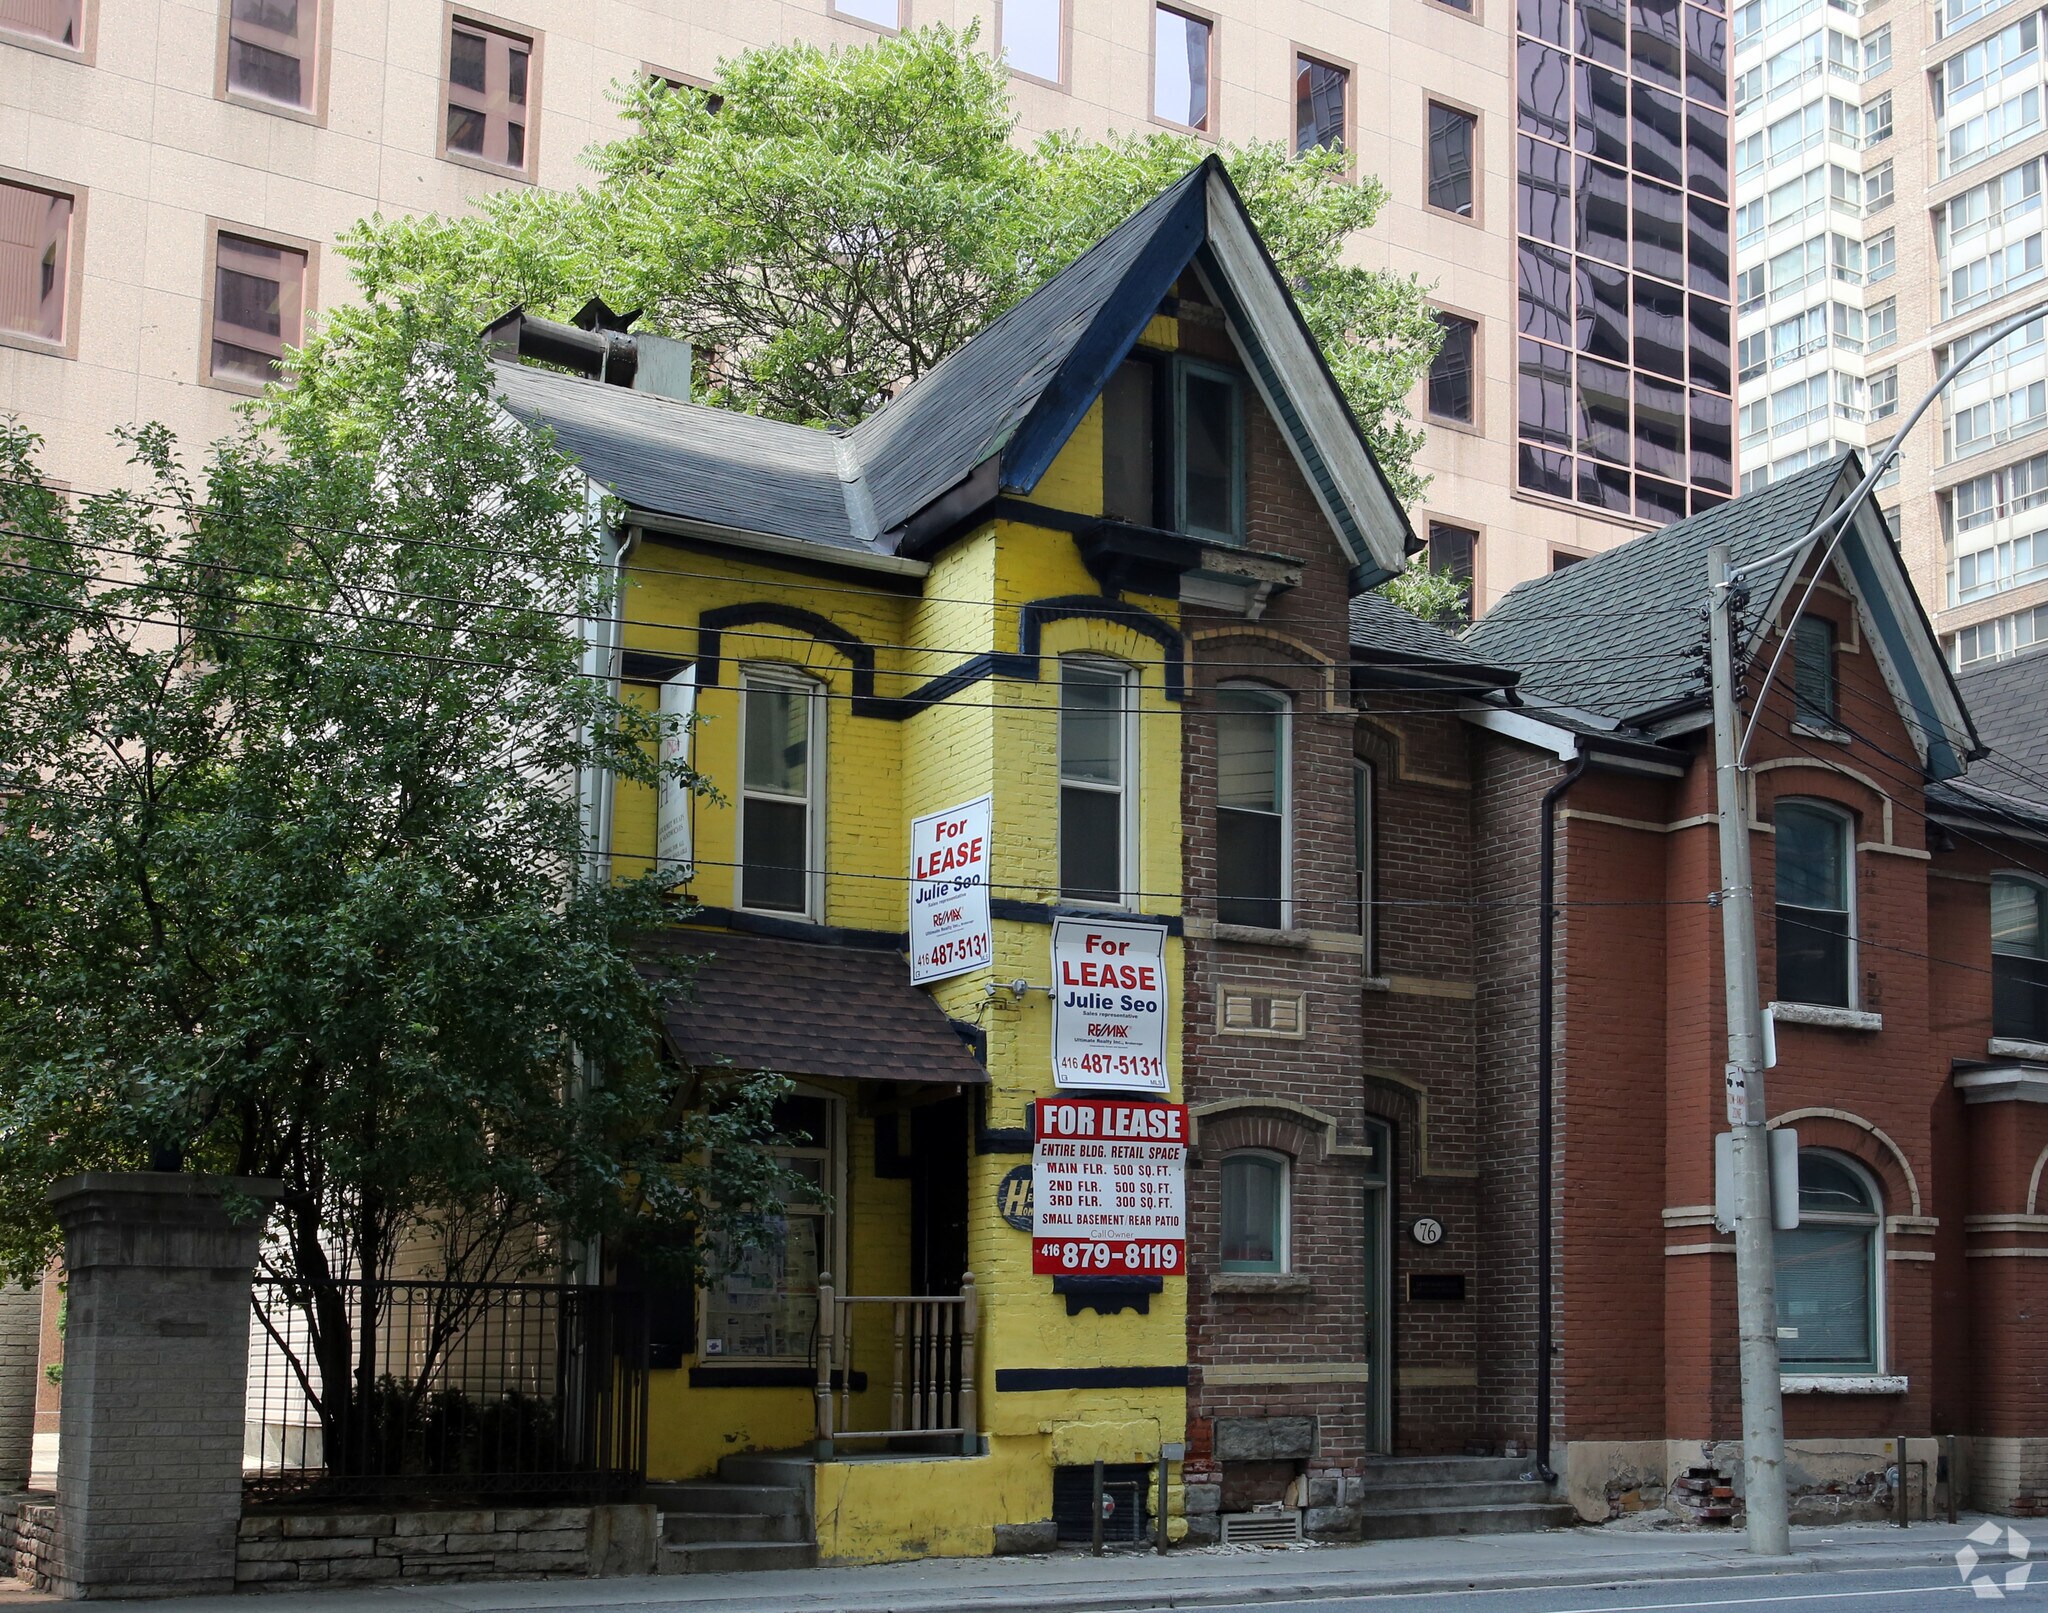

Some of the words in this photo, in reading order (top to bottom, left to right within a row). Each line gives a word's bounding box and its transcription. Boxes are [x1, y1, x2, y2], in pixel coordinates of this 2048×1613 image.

[935, 819, 968, 842] For
[916, 837, 983, 880] LEASE
[915, 882, 949, 904] Julie
[954, 874, 981, 892] Seo
[933, 907, 963, 928] RE/MAX
[917, 953, 930, 966] 416
[931, 932, 987, 966] 487-5131
[1085, 934, 1131, 956] For
[1062, 961, 1156, 991] LEASE
[1064, 992, 1113, 1010] Julie
[1120, 995, 1158, 1013] Seo
[1088, 1023, 1129, 1038] RE/MAX
[1061, 1056, 1078, 1069] 416
[1081, 1053, 1159, 1077] 487-5131
[1042, 1105, 1095, 1136] FOR
[1102, 1107, 1181, 1139] LEASE
[1041, 1143, 1076, 1157] ENTIRE
[1079, 1145, 1107, 1158] BLDG.
[1111, 1146, 1144, 1159] RETAIL
[1148, 1147, 1180, 1160] SPACE
[1047, 1162, 1078, 1174] MAIN
[1083, 1163, 1107, 1175] FLR.
[1113, 1164, 1134, 1176] 500
[1049, 1180, 1073, 1191] 2ND
[1078, 1181, 1102, 1193] FLR.
[1115, 1182, 1135, 1193] 500
[1049, 1195, 1073, 1206] 3RD
[1078, 1195, 1102, 1207] FLR.
[1116, 1196, 1136, 1208] 300
[1042, 1213, 1073, 1225] SMALL
[1155, 1215, 1180, 1227] PATIO
[1420, 1222, 1436, 1242] 76
[1041, 1244, 1060, 1257] 416
[1062, 1242, 1178, 1269] 879-8119
